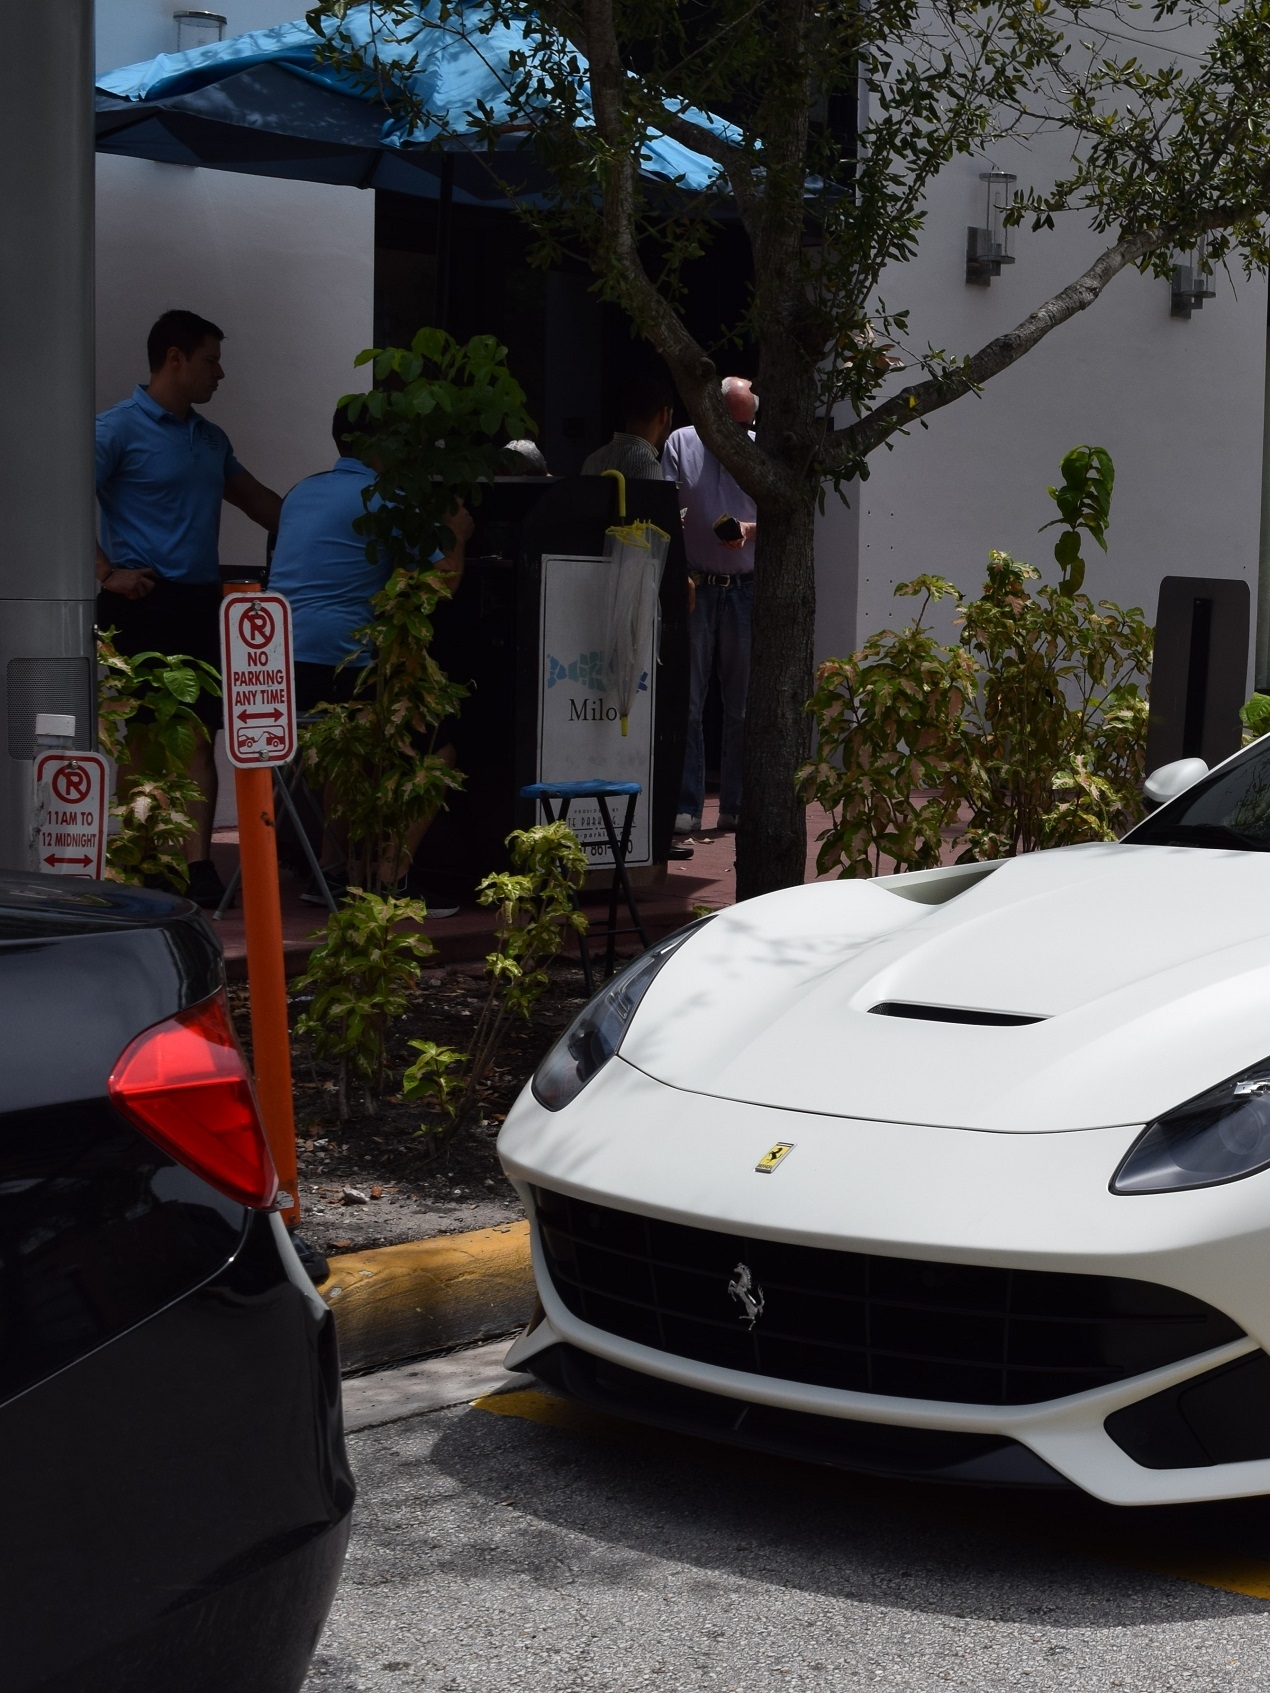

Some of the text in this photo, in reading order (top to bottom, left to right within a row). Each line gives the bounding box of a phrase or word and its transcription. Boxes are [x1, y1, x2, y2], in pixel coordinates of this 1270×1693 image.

[247, 650, 269, 667] NO
[233, 669, 284, 687] PARKING
[235, 689, 285, 706] ANY TIME
[568, 698, 622, 721] Milo
[47, 811, 94, 826] 11AM TO
[42, 832, 97, 848] 12 MIDNIGHT
